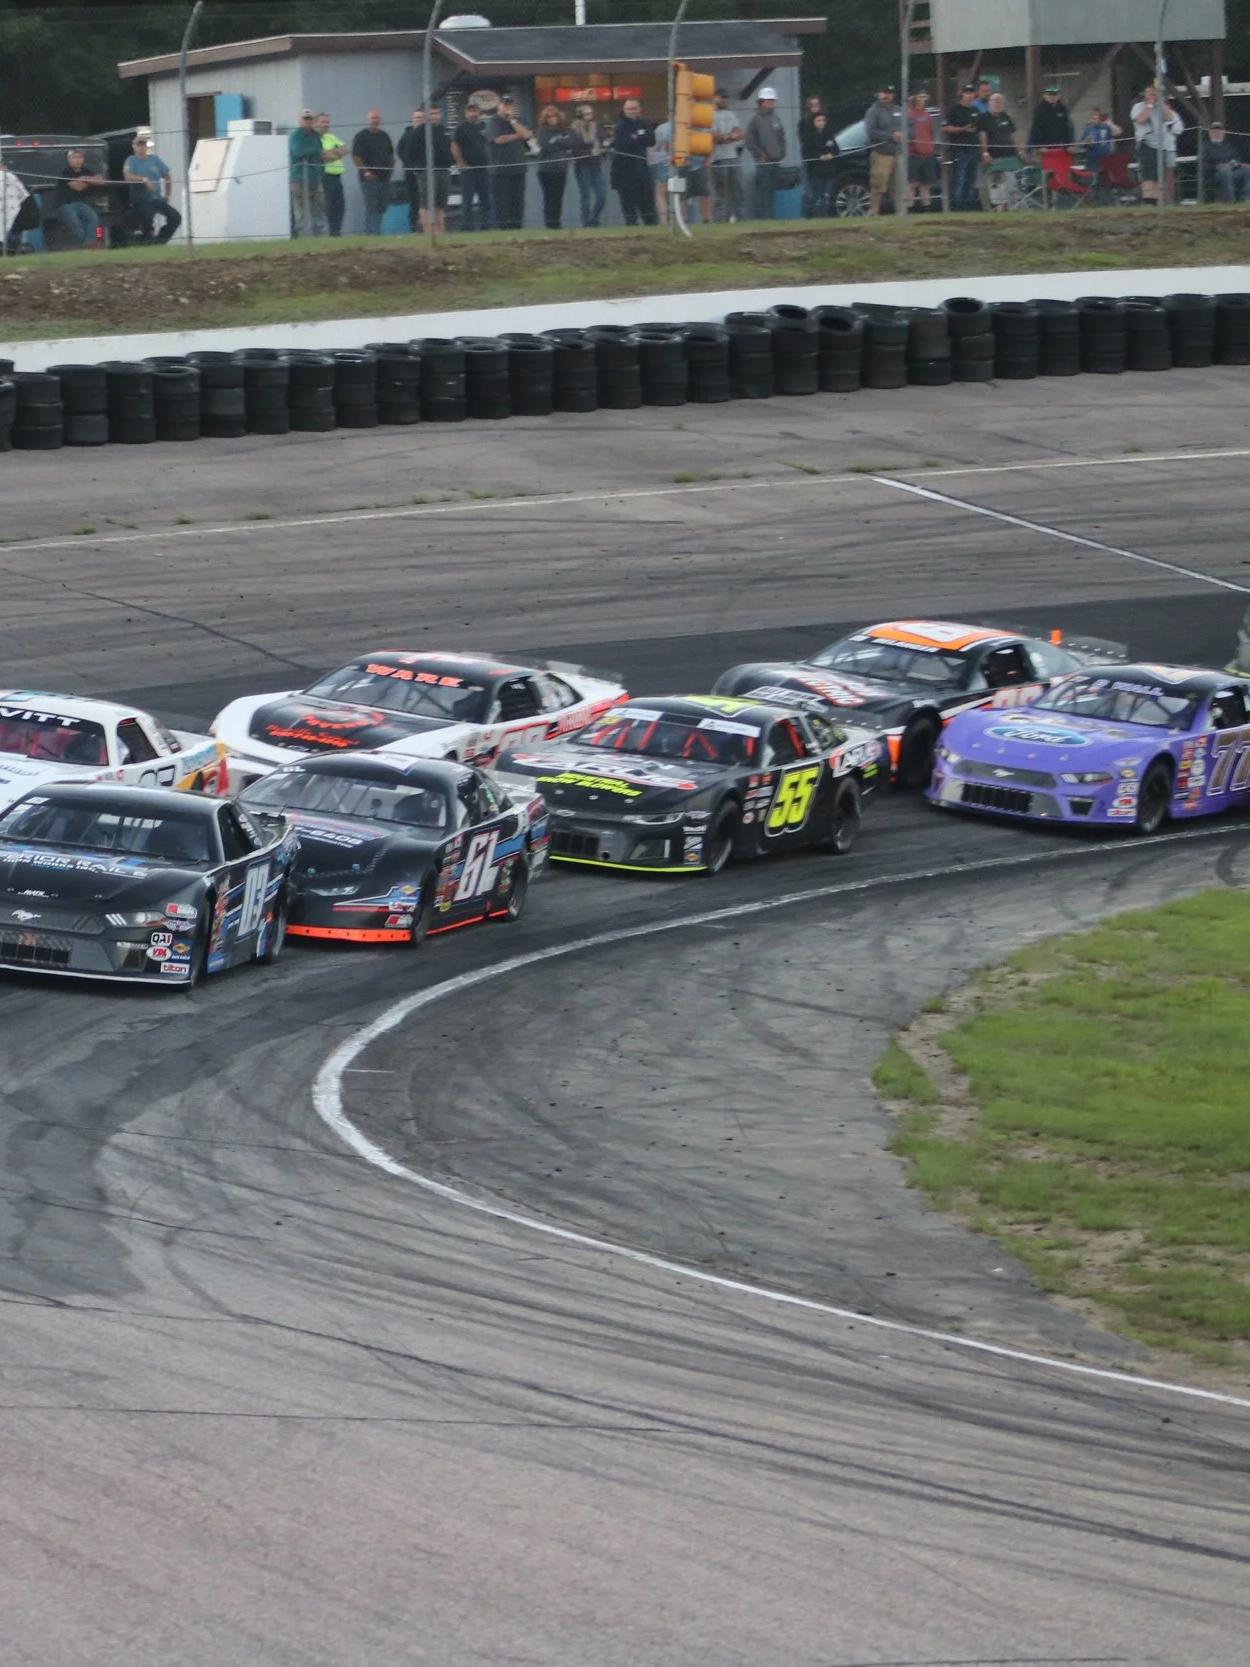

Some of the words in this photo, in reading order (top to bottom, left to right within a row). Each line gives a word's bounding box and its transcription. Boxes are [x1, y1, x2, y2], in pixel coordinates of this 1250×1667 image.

[768, 767, 820, 829] 55
[76, 859, 126, 875] RAIL
[152, 933, 172, 945] QA1
